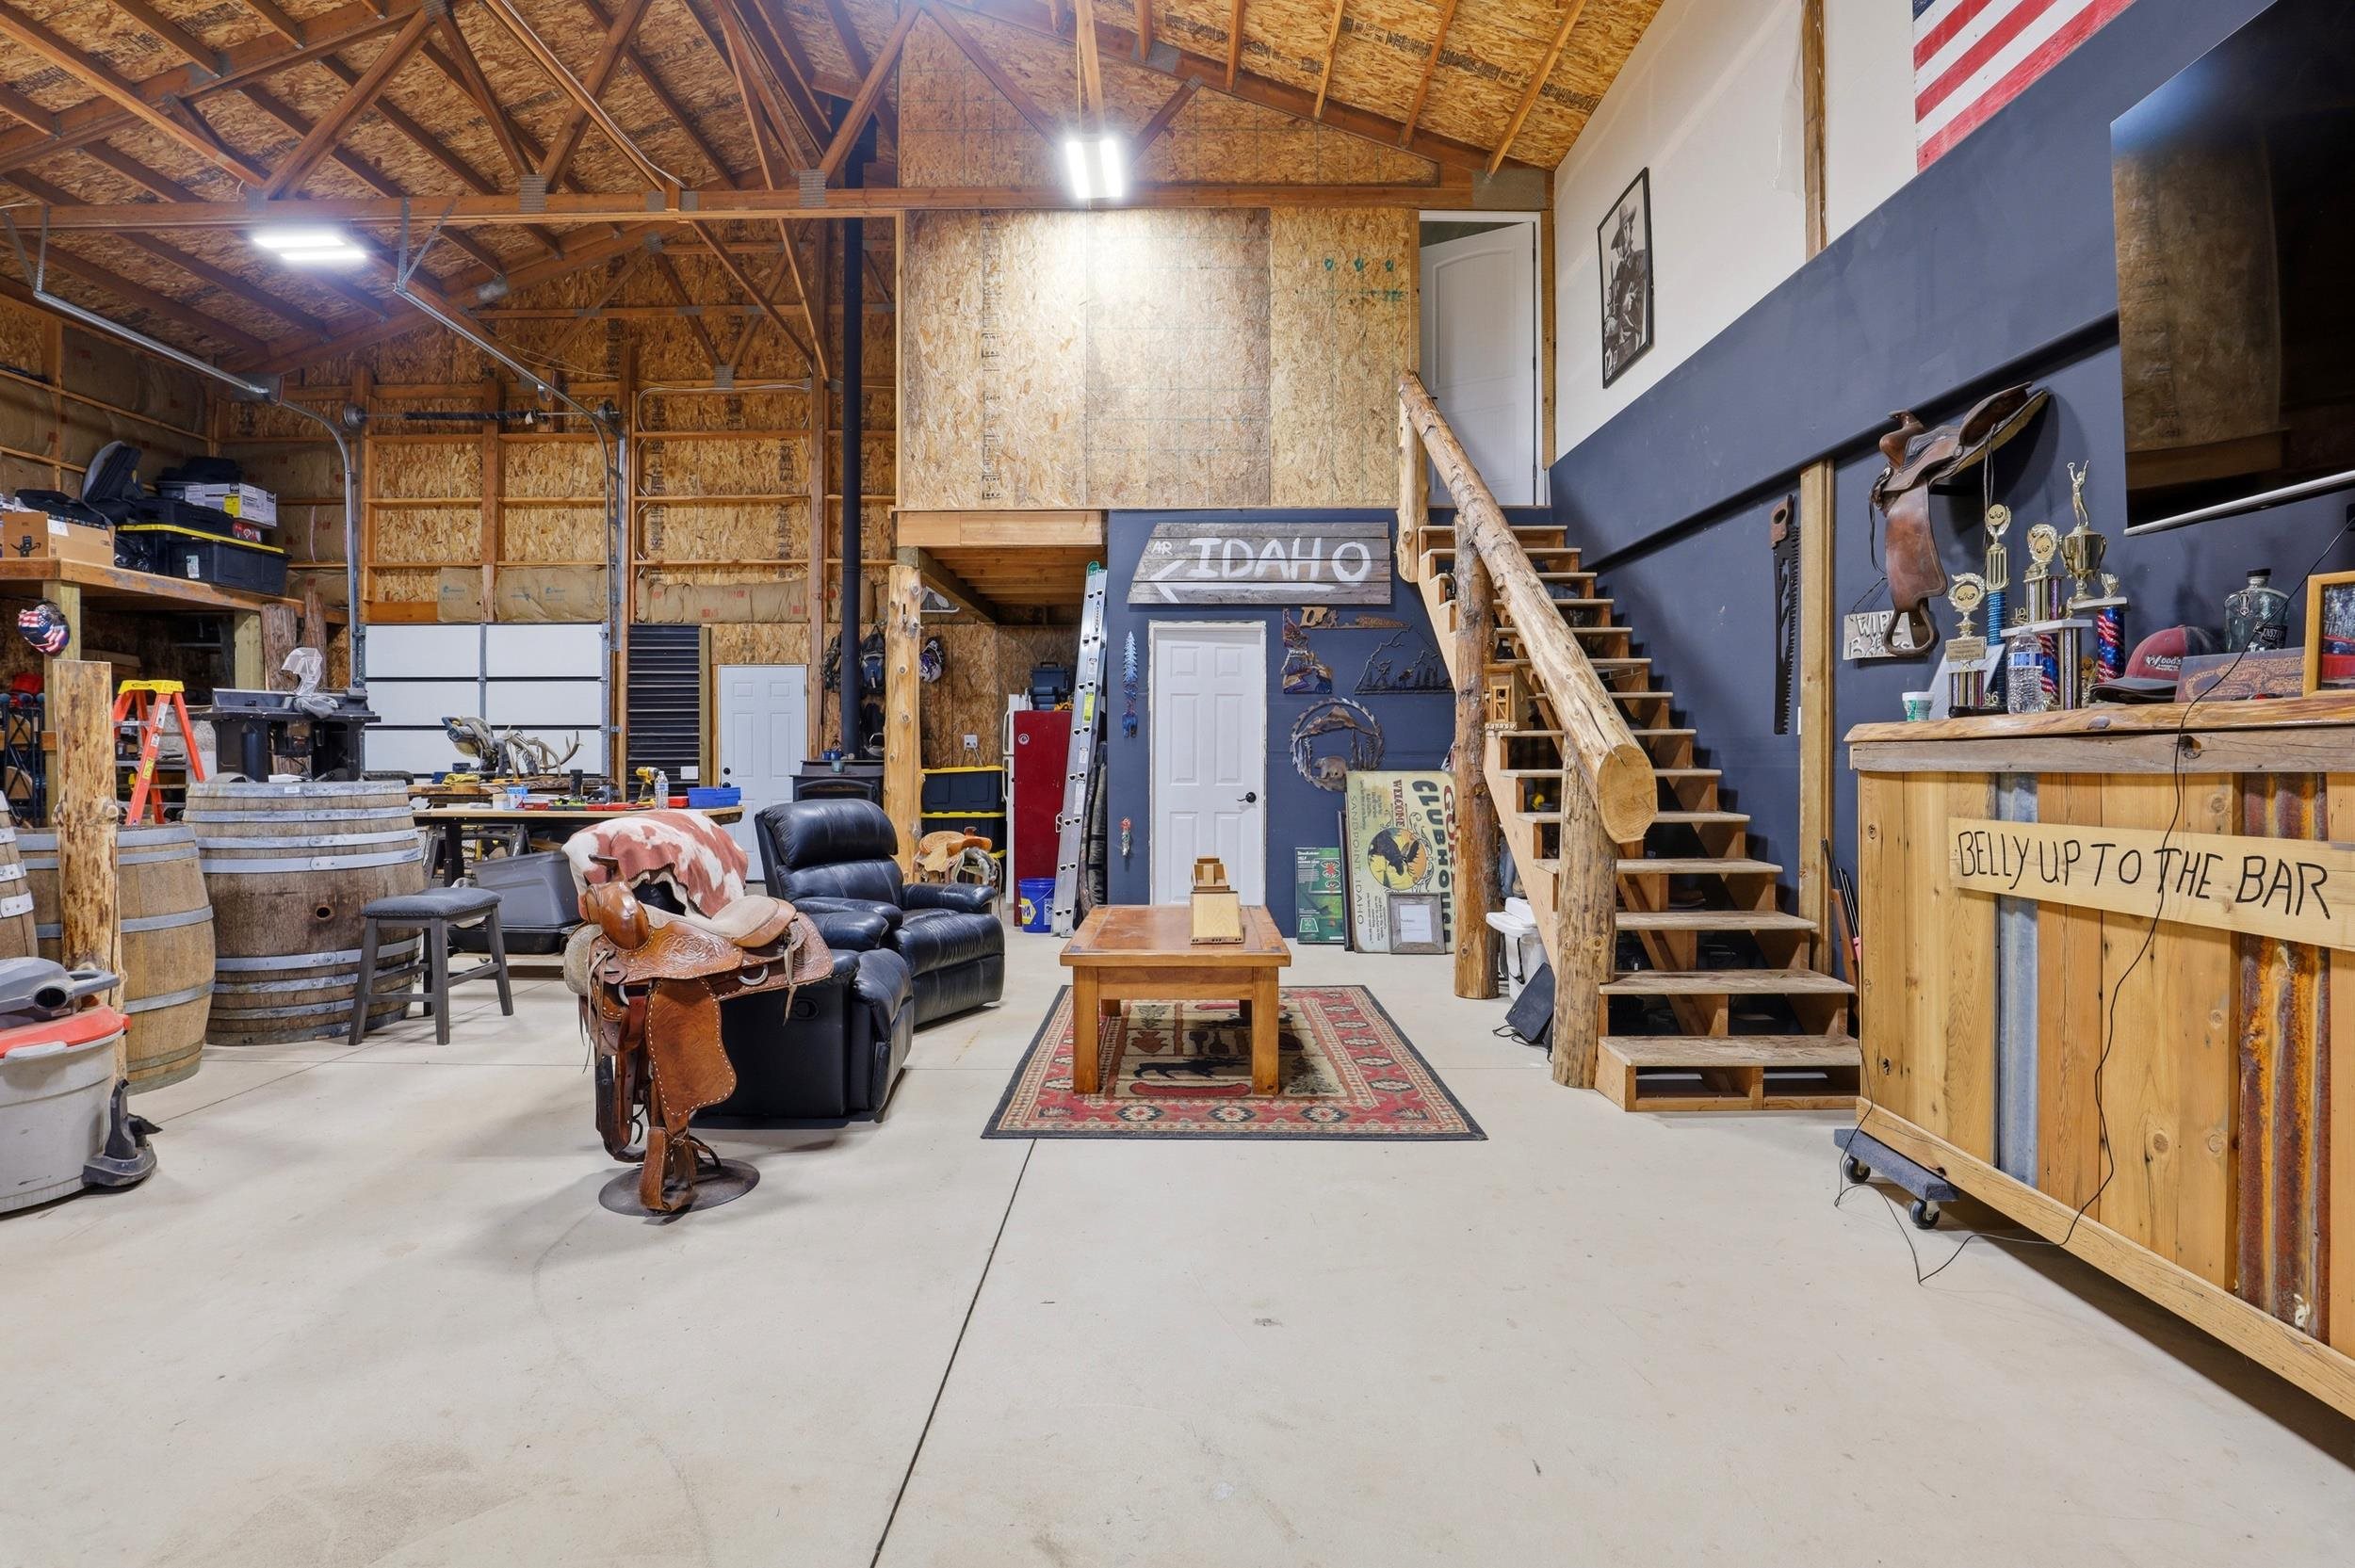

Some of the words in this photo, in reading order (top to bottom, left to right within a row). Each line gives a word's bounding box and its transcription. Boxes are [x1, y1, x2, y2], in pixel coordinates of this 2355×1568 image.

[1189, 537, 1372, 586] IDAHO
[1984, 690, 1999, 704] 96
[1392, 779, 1405, 827] WELCOME
[1957, 831, 2030, 890] BELLY
[2038, 839, 2081, 887] UP
[2152, 848, 2224, 899] THE
[2234, 855, 2331, 920] BAR
[1356, 880, 1364, 925] IDAHO
